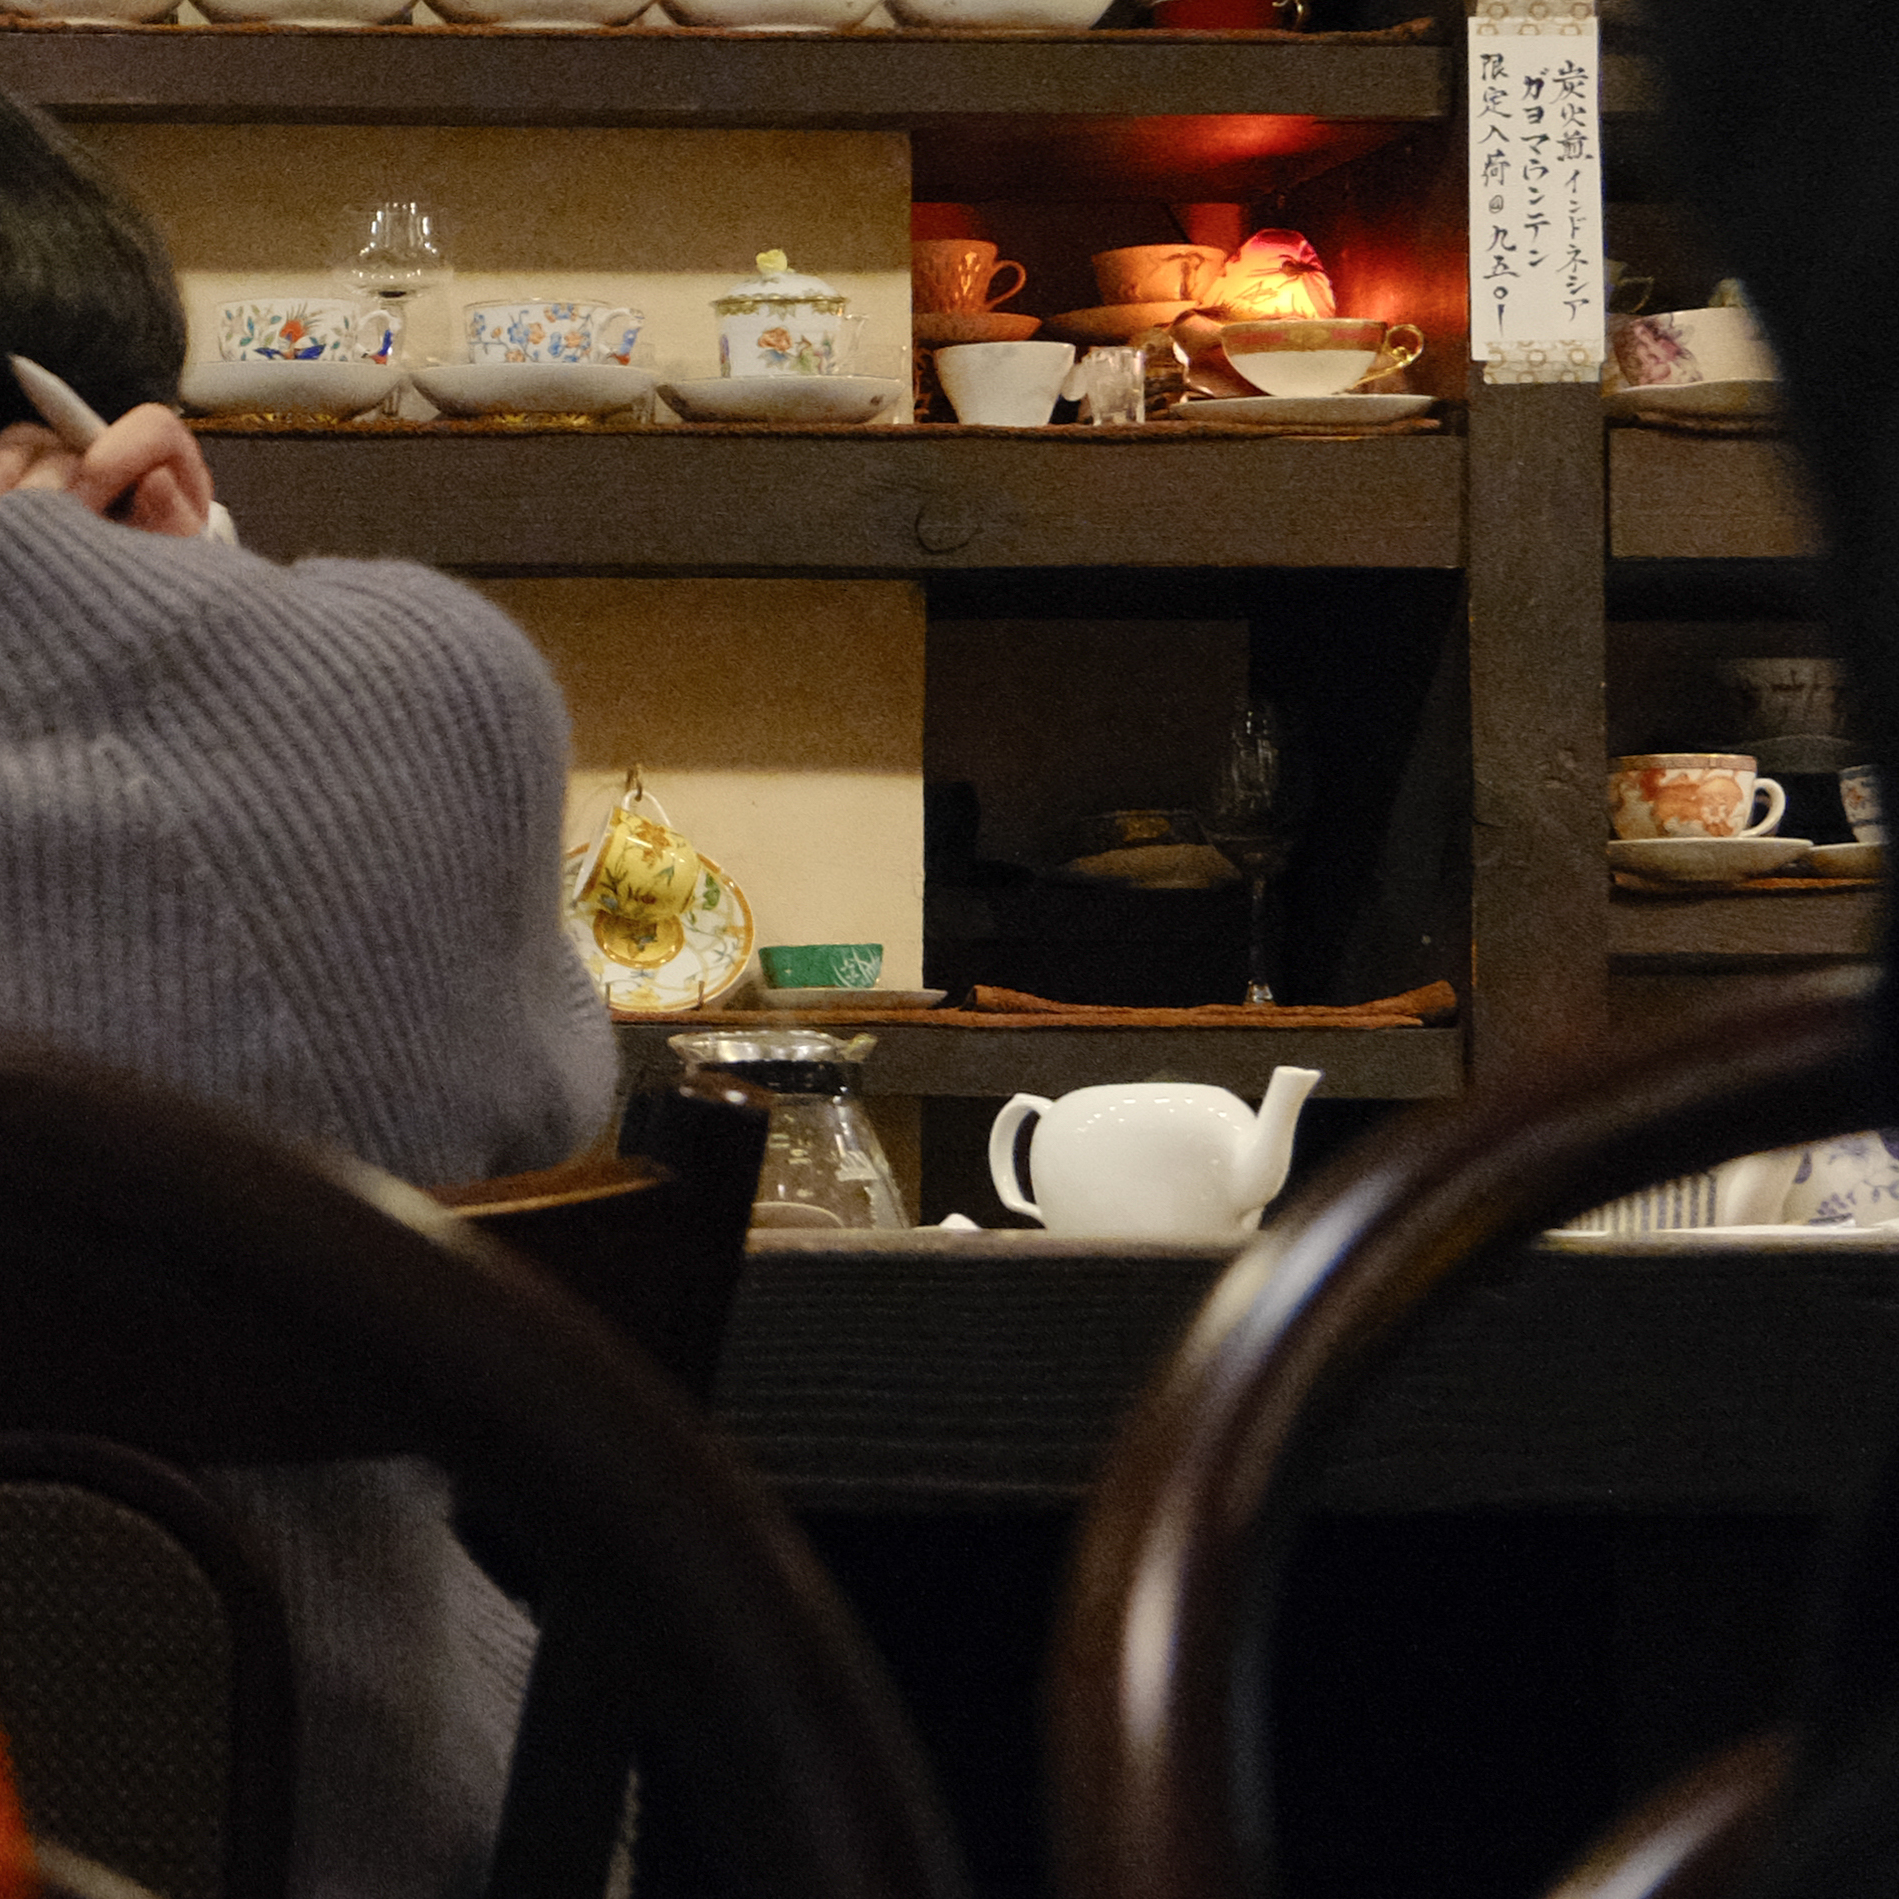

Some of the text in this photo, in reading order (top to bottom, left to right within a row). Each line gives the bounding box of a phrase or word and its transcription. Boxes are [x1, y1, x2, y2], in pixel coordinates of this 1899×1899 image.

[1520, 66, 1551, 268] ガヨマウンテン
[1552, 59, 1594, 323] 炭火煎インドネシア
